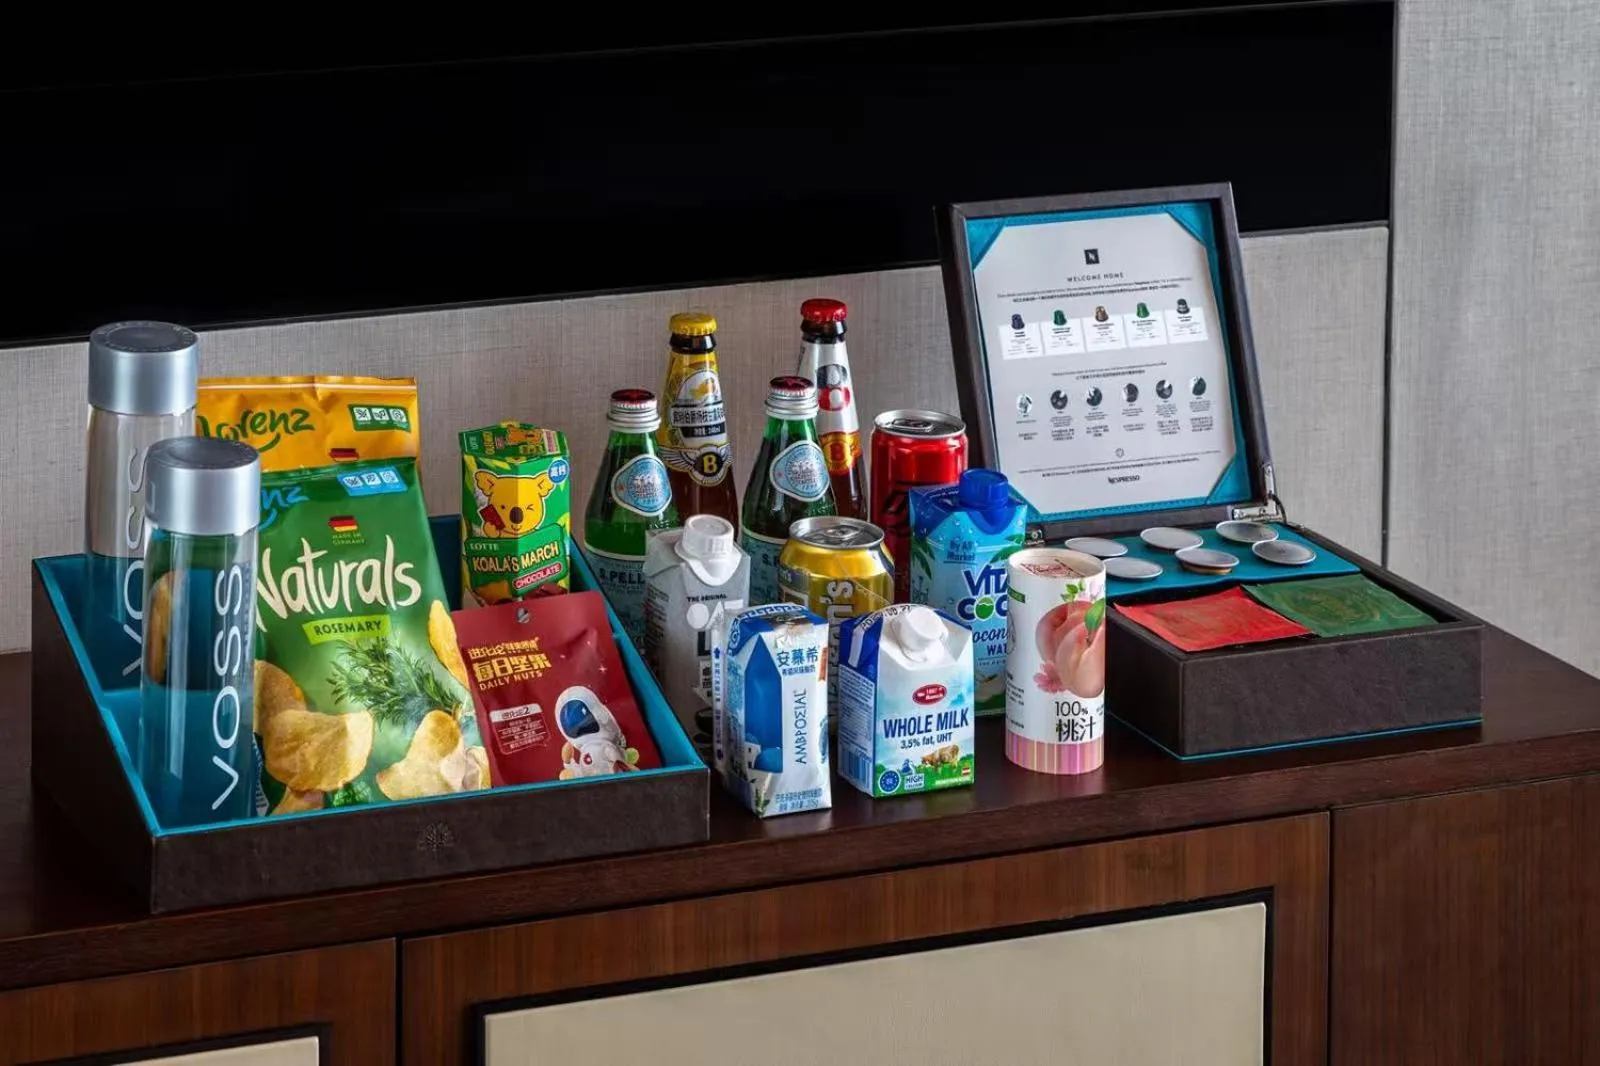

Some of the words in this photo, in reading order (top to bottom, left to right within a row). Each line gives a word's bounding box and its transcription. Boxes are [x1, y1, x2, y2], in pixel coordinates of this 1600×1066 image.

[1066, 273, 1101, 282] WELCOME
[1103, 271, 1124, 280] HOME
[703, 454, 718, 474] B
[1107, 474, 1141, 485] NESPRESSO
[470, 542, 499, 551] LOTTE
[472, 555, 520, 573] KOALA'S
[520, 541, 560, 569] MARCH
[255, 534, 422, 633] Naturals
[515, 565, 561, 588] CHOCOLATE
[314, 620, 382, 636] ROSEMARY
[776, 646, 818, 668] 安慕希
[211, 564, 243, 811] VOSS
[479, 676, 511, 691] DAILY
[513, 670, 543, 681] NUTS
[1054, 700, 1089, 717] 100%
[883, 714, 933, 739] WHOLE
[936, 707, 969, 732] MILK
[1055, 715, 1097, 742] 桃汁
[922, 735, 935, 746] fat,
[936, 732, 953, 744] UHT
[906, 775, 923, 784] HIGH
